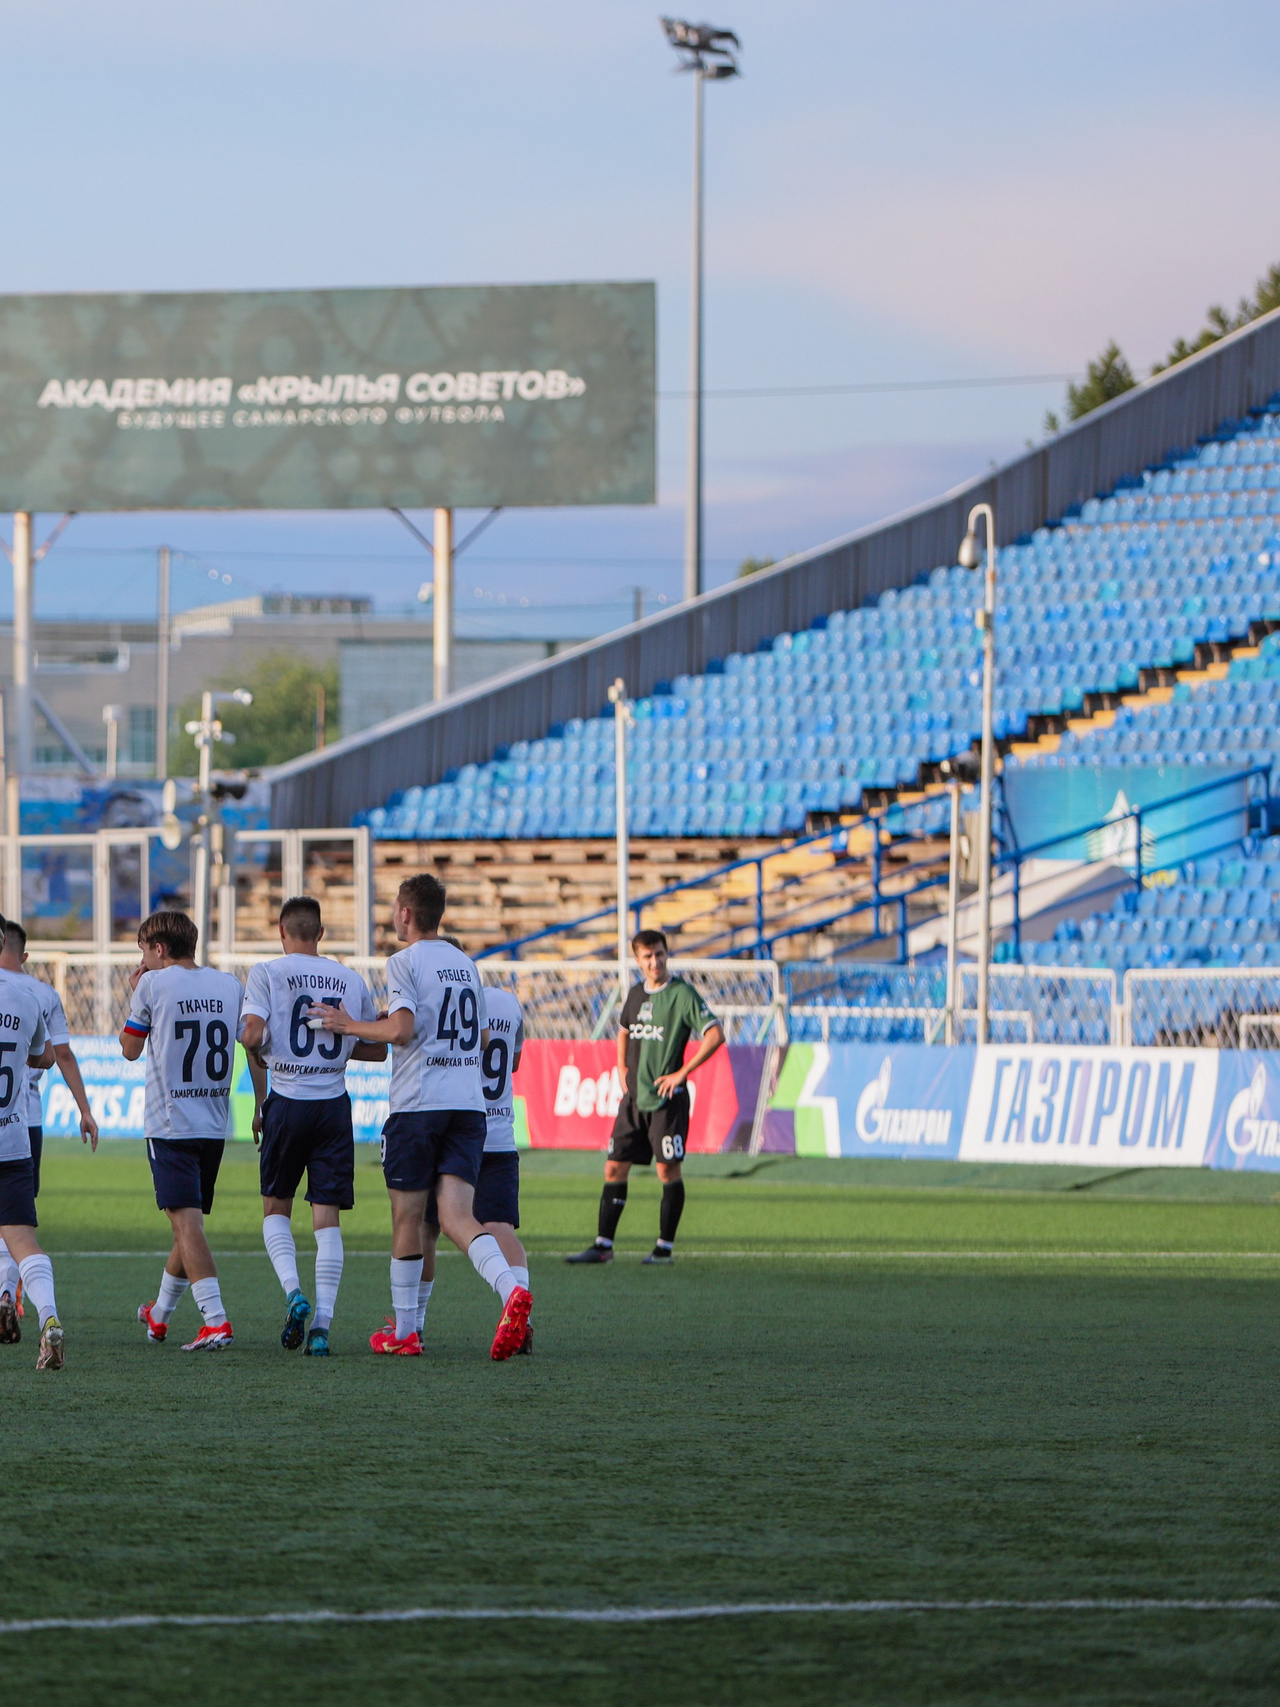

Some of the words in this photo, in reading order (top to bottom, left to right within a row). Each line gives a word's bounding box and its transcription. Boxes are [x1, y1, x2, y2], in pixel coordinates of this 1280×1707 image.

[37, 377, 233, 411] АКАДЕМИЯ
[236, 373, 401, 406] «КРЫЛЬЯ
[404, 369, 587, 402] СОВЕТОВ»
[117, 410, 227, 431] БУДУЩЕЕ
[232, 406, 387, 428] САМАРСКОГО
[394, 404, 505, 424] ФУТБОЛА
[286, 974, 347, 996] МУТОВКИН
[436, 969, 472, 983] РЯБЦЕВ
[177, 999, 224, 1015] ТКАЧЕВ
[436, 986, 479, 1052] 49
[488, 1018, 511, 1034] КИН
[175, 1020, 229, 1083] 78
[984, 1057, 1196, 1149] ГАЗПРОМ
[881, 1108, 952, 1145] ГАЗПРОМ
[661, 1134, 684, 1161] 68
